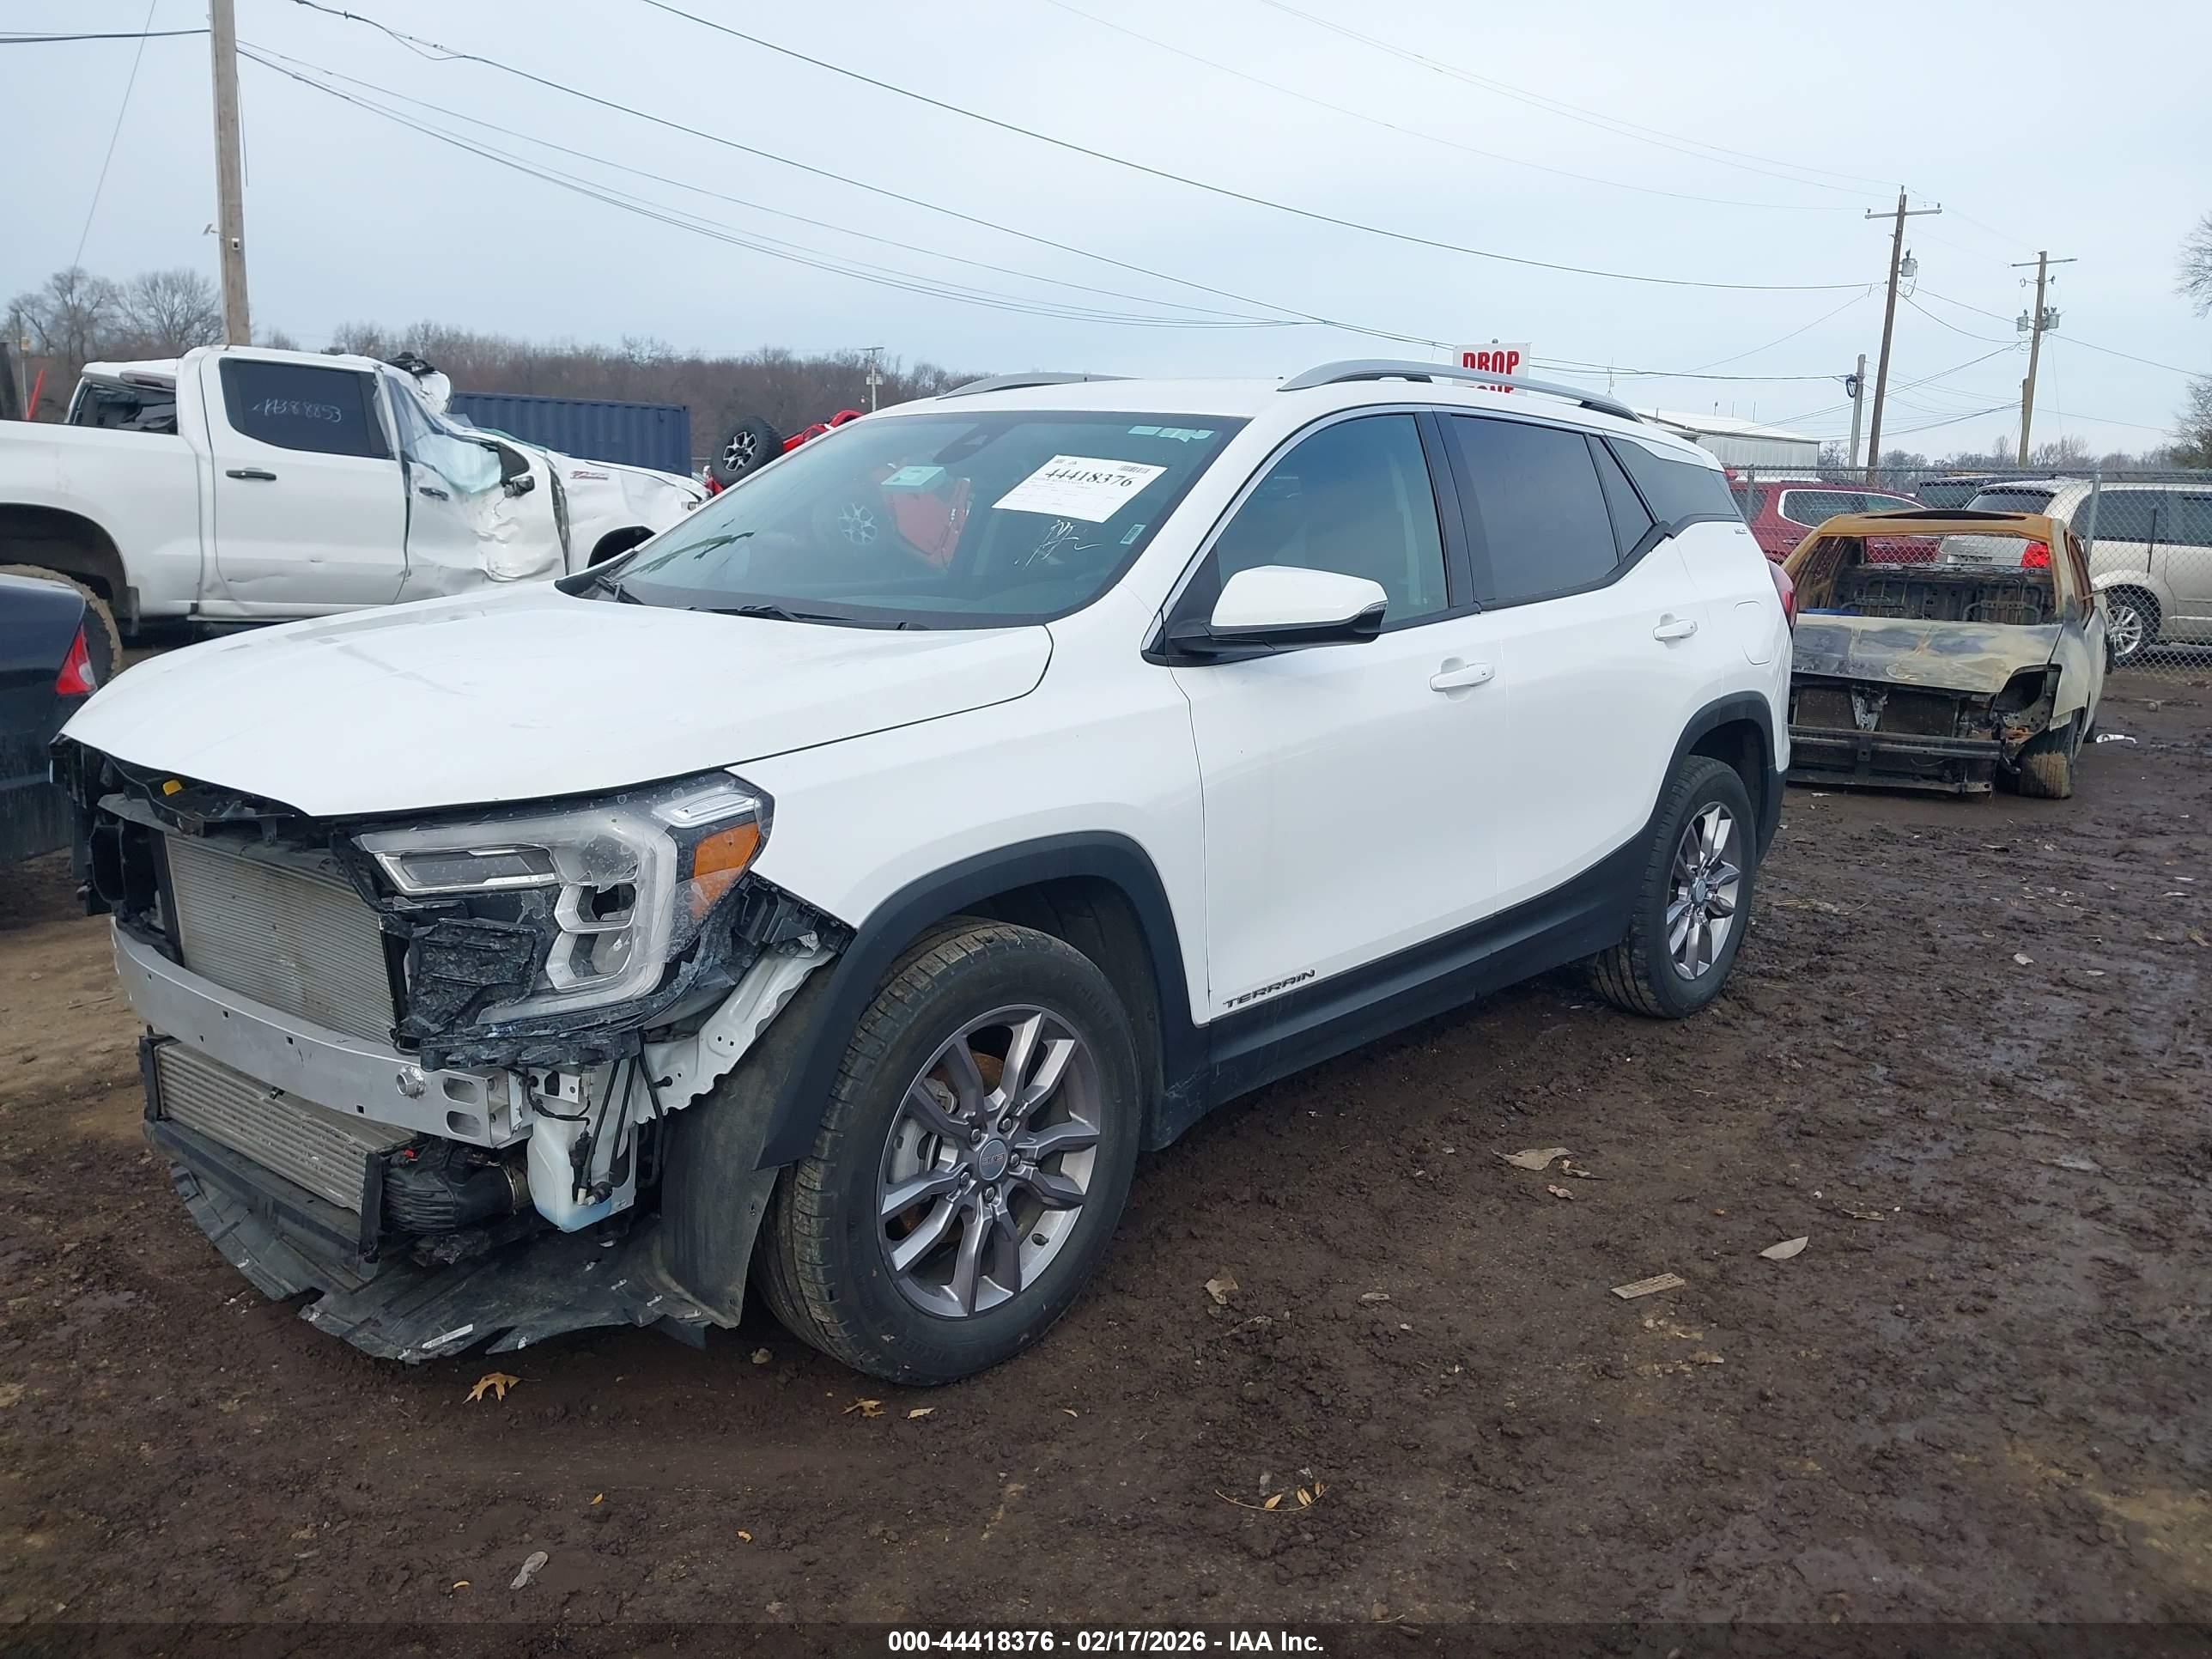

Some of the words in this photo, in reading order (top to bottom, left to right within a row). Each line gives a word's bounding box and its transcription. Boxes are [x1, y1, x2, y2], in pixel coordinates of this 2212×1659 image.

[1462, 350, 1520, 375] DROP
[1045, 468, 1139, 487] 44418376
[1223, 969, 1316, 1008] TERRAIN
